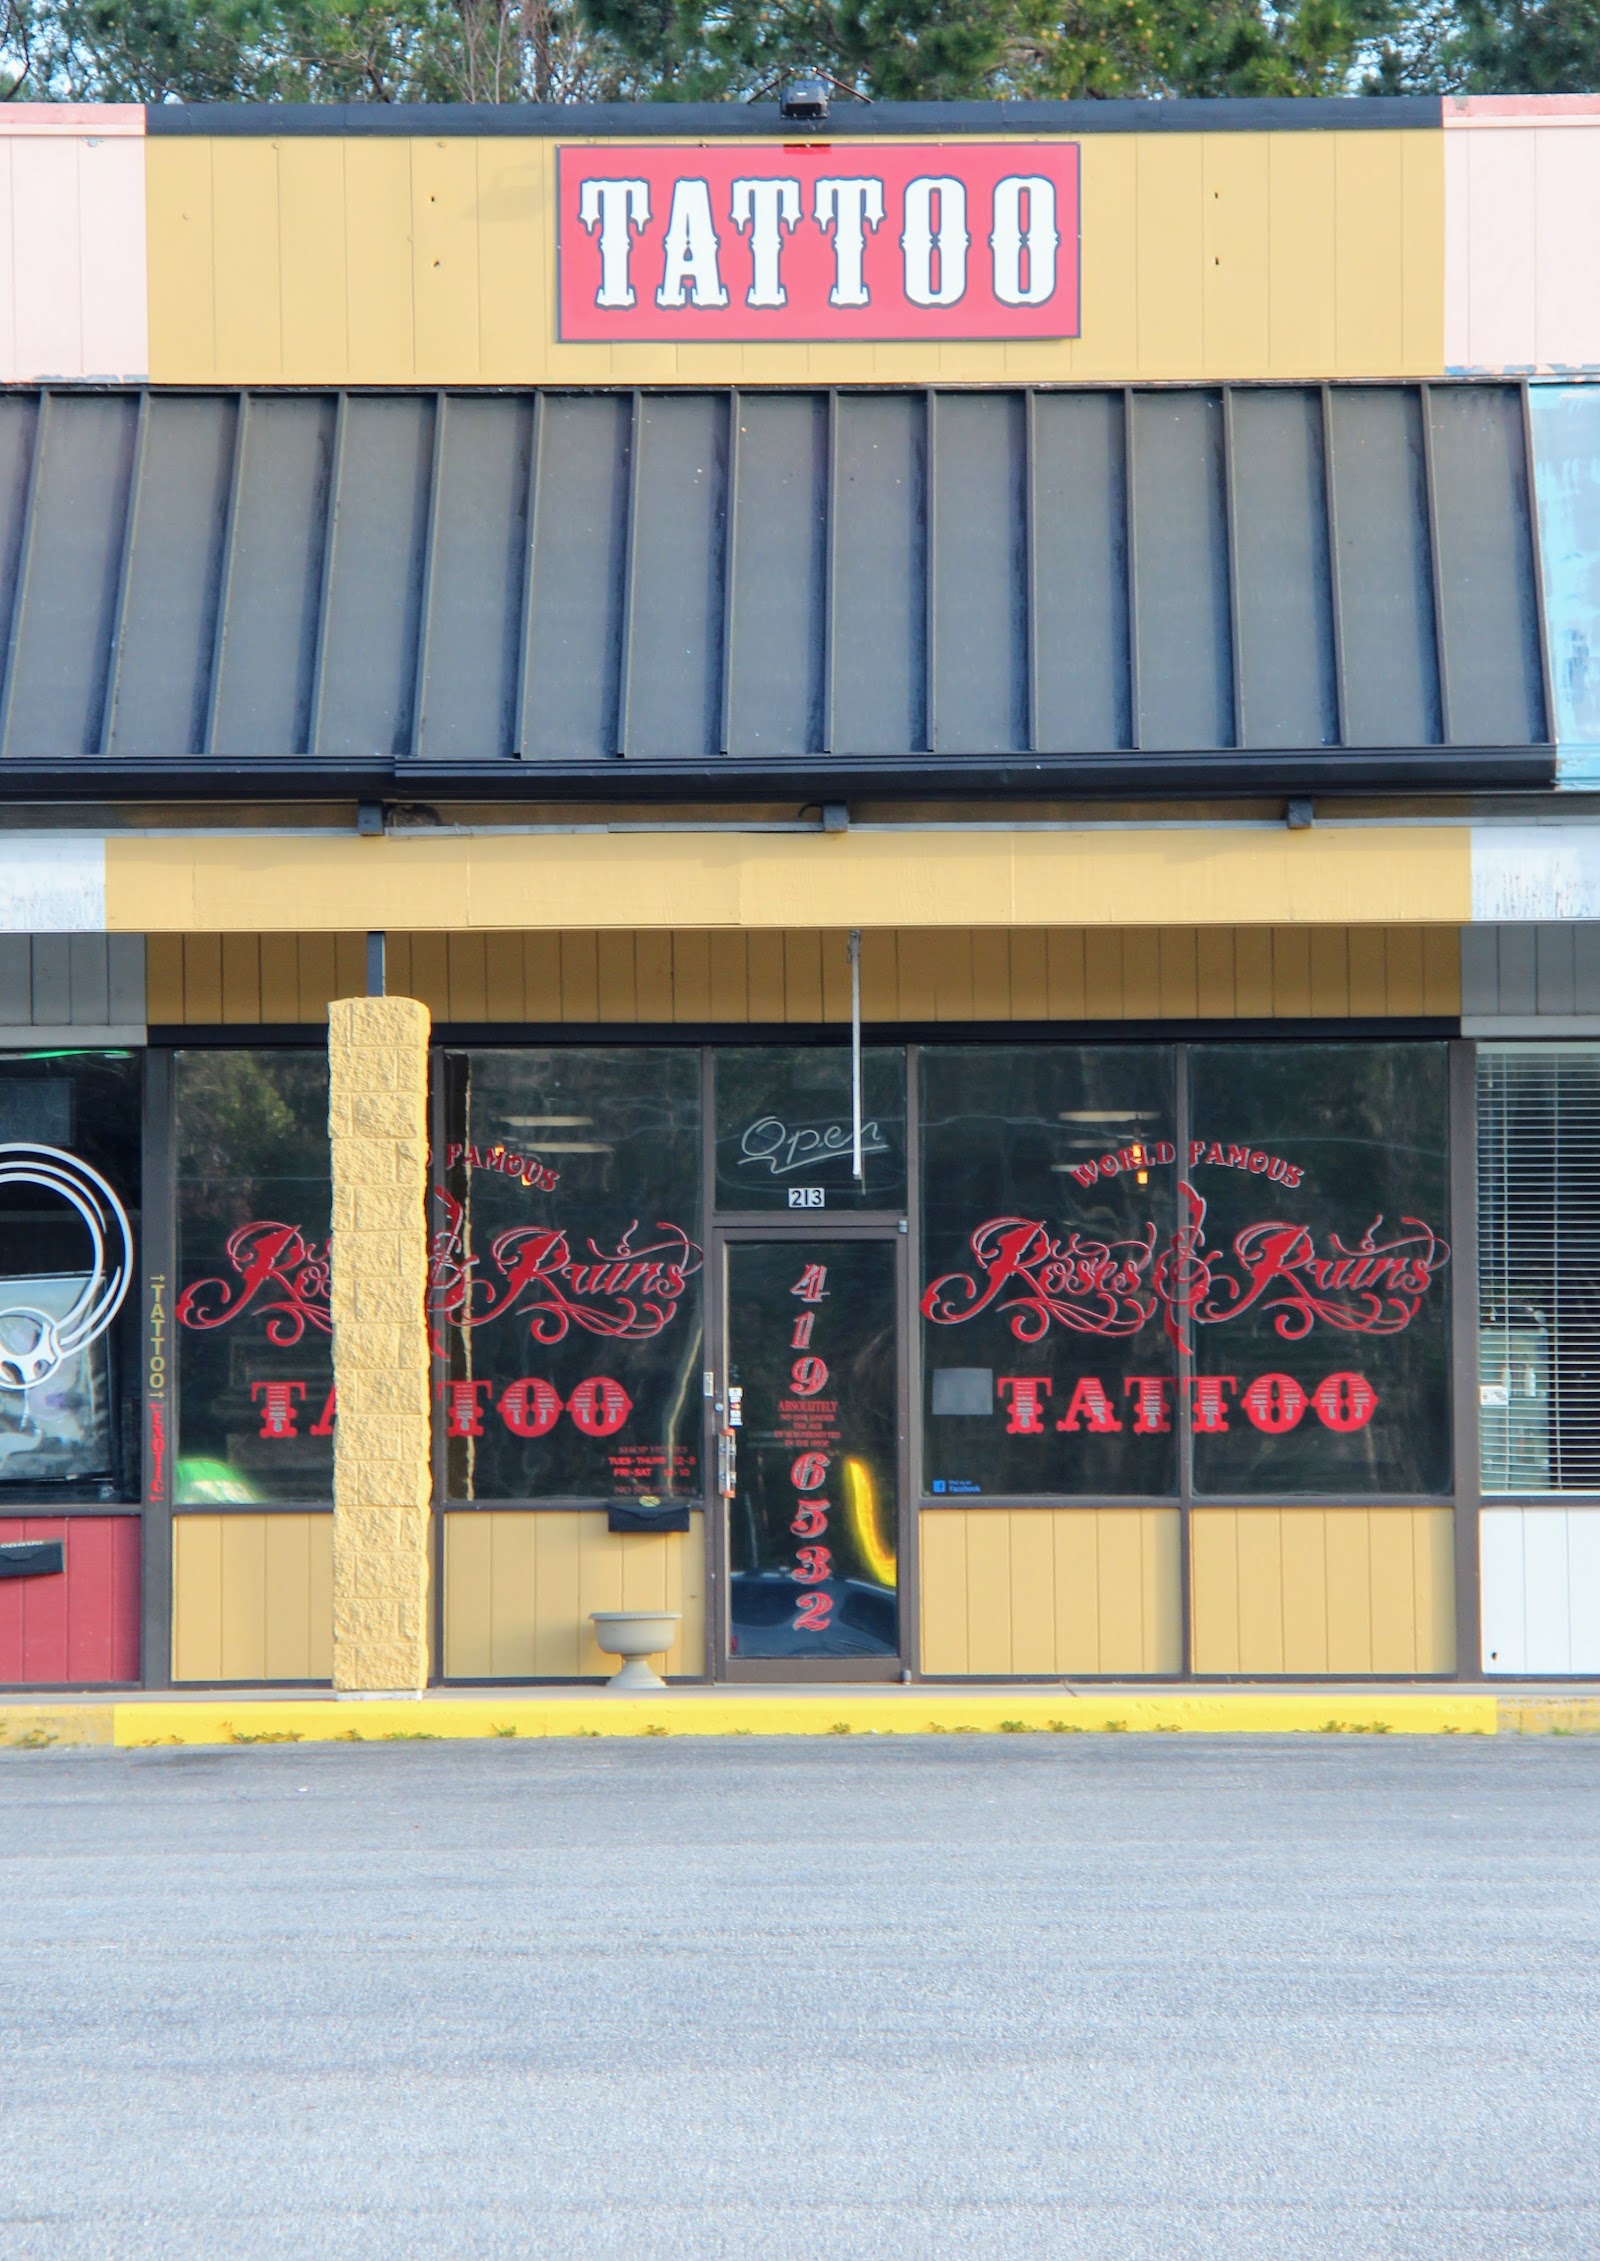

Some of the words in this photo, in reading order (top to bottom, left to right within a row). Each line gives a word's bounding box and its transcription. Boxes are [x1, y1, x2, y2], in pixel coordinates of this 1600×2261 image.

[577, 175, 1060, 310] TATTOO
[446, 1143, 560, 1192] FAMOUS
[791, 1190, 822, 1206] 213
[1070, 1141, 1176, 1188] WORLD
[1189, 1141, 1304, 1188] FAMOUS
[445, 1218, 704, 1345] Ruins
[921, 1217, 1158, 1343] Roses
[1190, 1214, 1451, 1340] Ruins
[150, 1284, 165, 1389] TATTOO
[997, 1371, 1379, 1434] TATTOO
